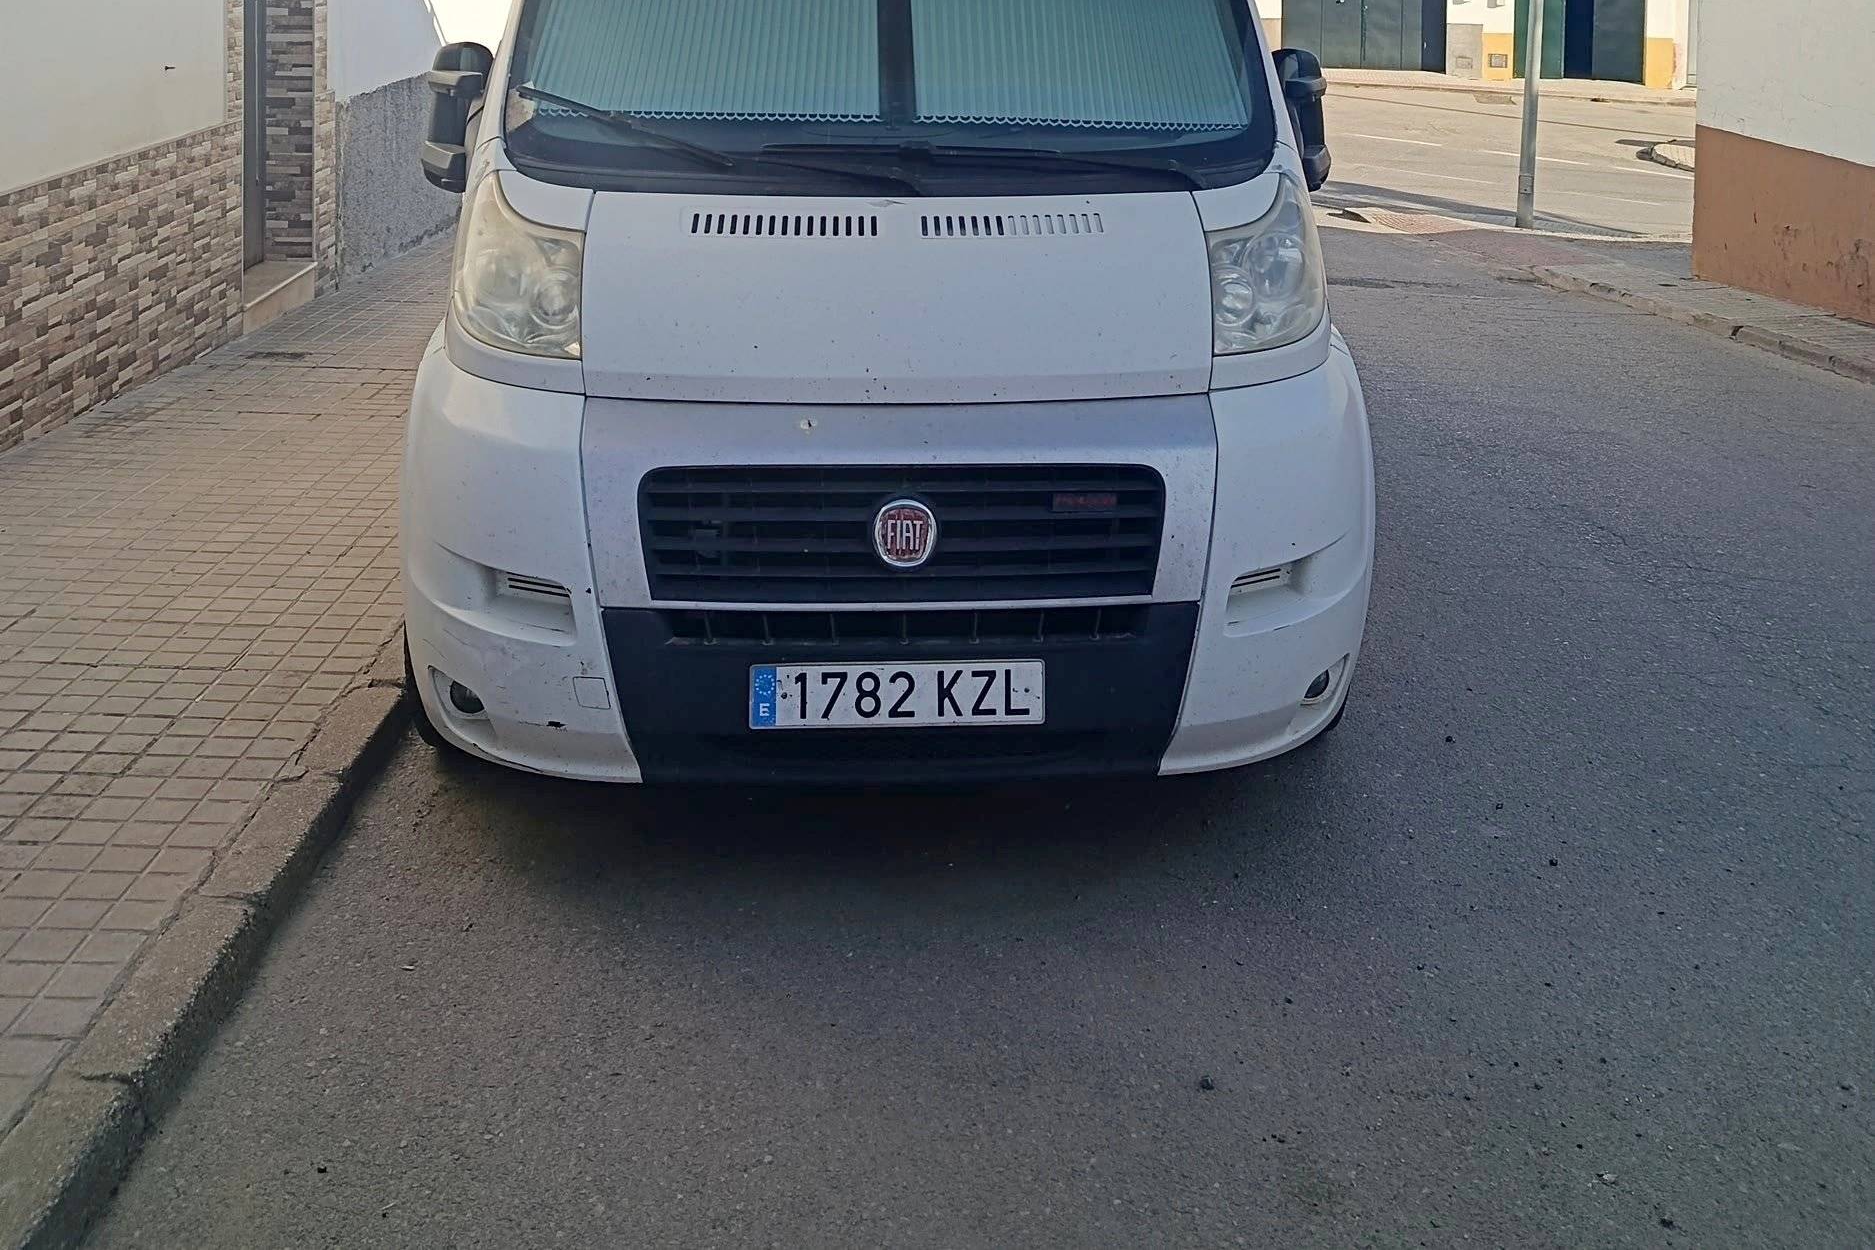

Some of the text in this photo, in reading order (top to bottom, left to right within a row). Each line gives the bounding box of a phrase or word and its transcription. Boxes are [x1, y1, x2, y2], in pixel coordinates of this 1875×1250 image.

[887, 519, 923, 550] FIAT
[759, 702, 770, 717] E
[794, 669, 1031, 719] 1782 KZL
